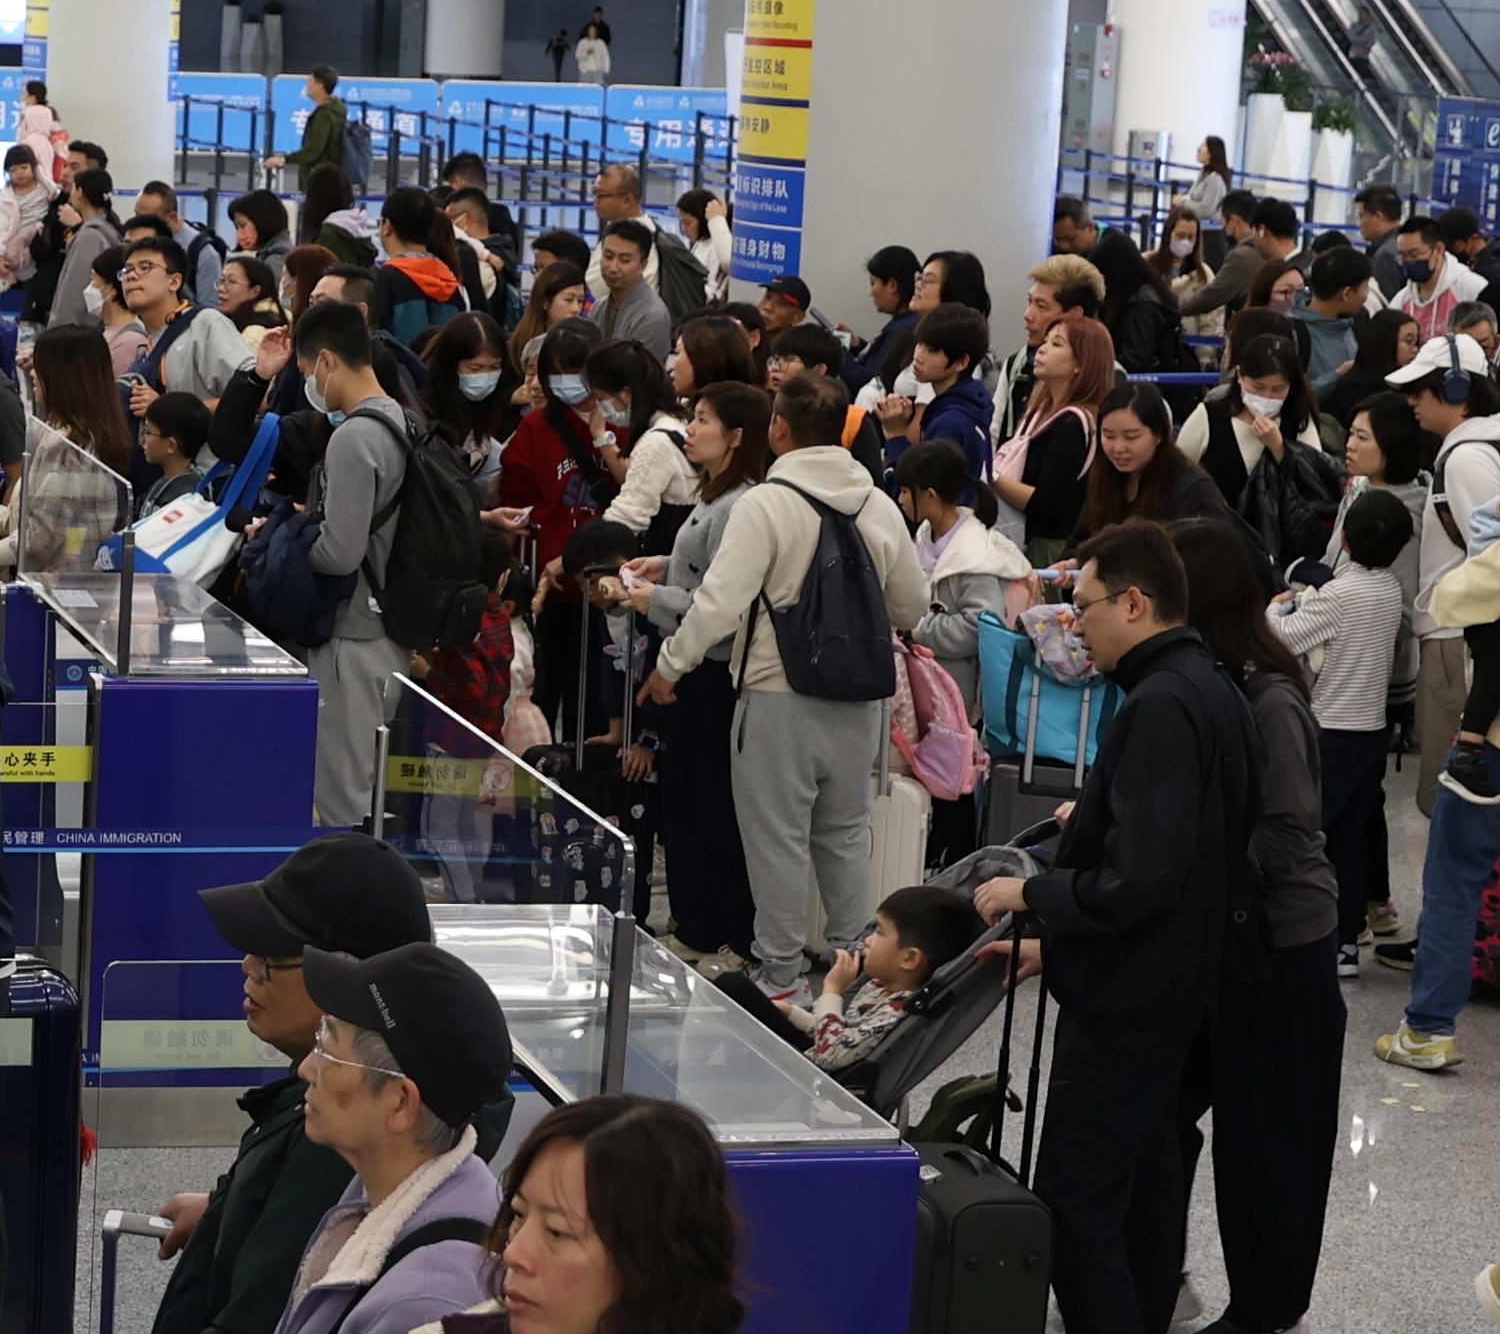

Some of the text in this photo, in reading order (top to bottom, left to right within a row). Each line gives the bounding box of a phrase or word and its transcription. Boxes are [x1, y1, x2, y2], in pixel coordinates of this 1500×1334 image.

[290, 108, 416, 141] 专通道
[0, 751, 57, 768] 心夹手
[0, 769, 20, 777] areful
[56, 831, 182, 845] CHINA IMMIGRATION
